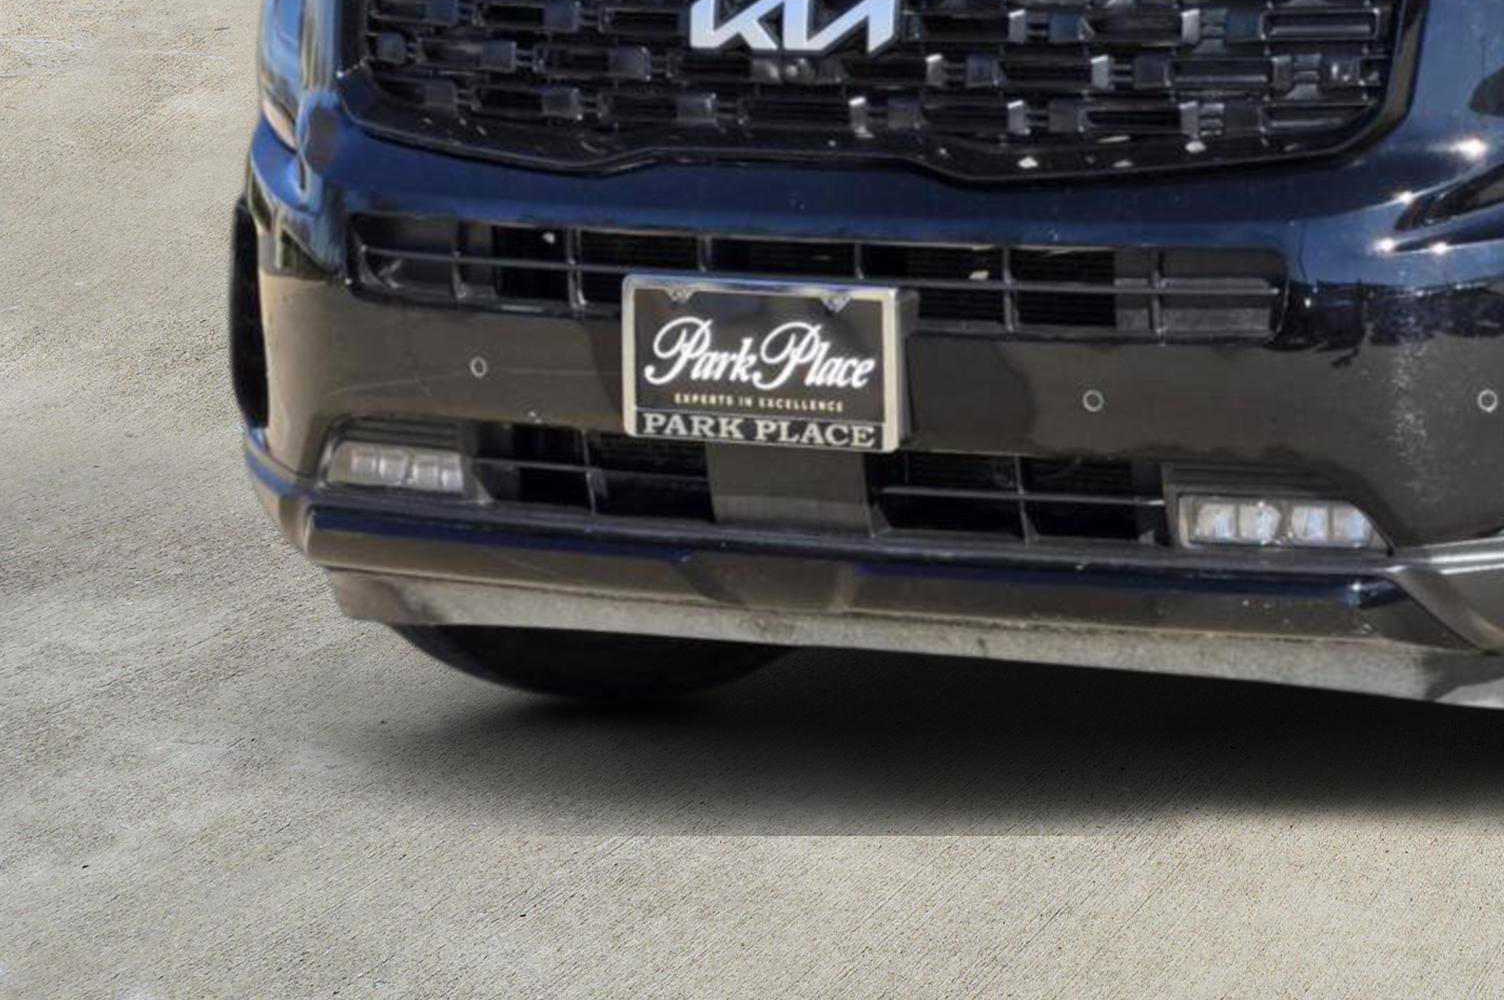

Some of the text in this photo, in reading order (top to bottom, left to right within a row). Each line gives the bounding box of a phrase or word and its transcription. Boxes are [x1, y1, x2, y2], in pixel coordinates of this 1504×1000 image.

[644, 316, 876, 390] Park Place
[643, 412, 876, 448] PARK PLACE
